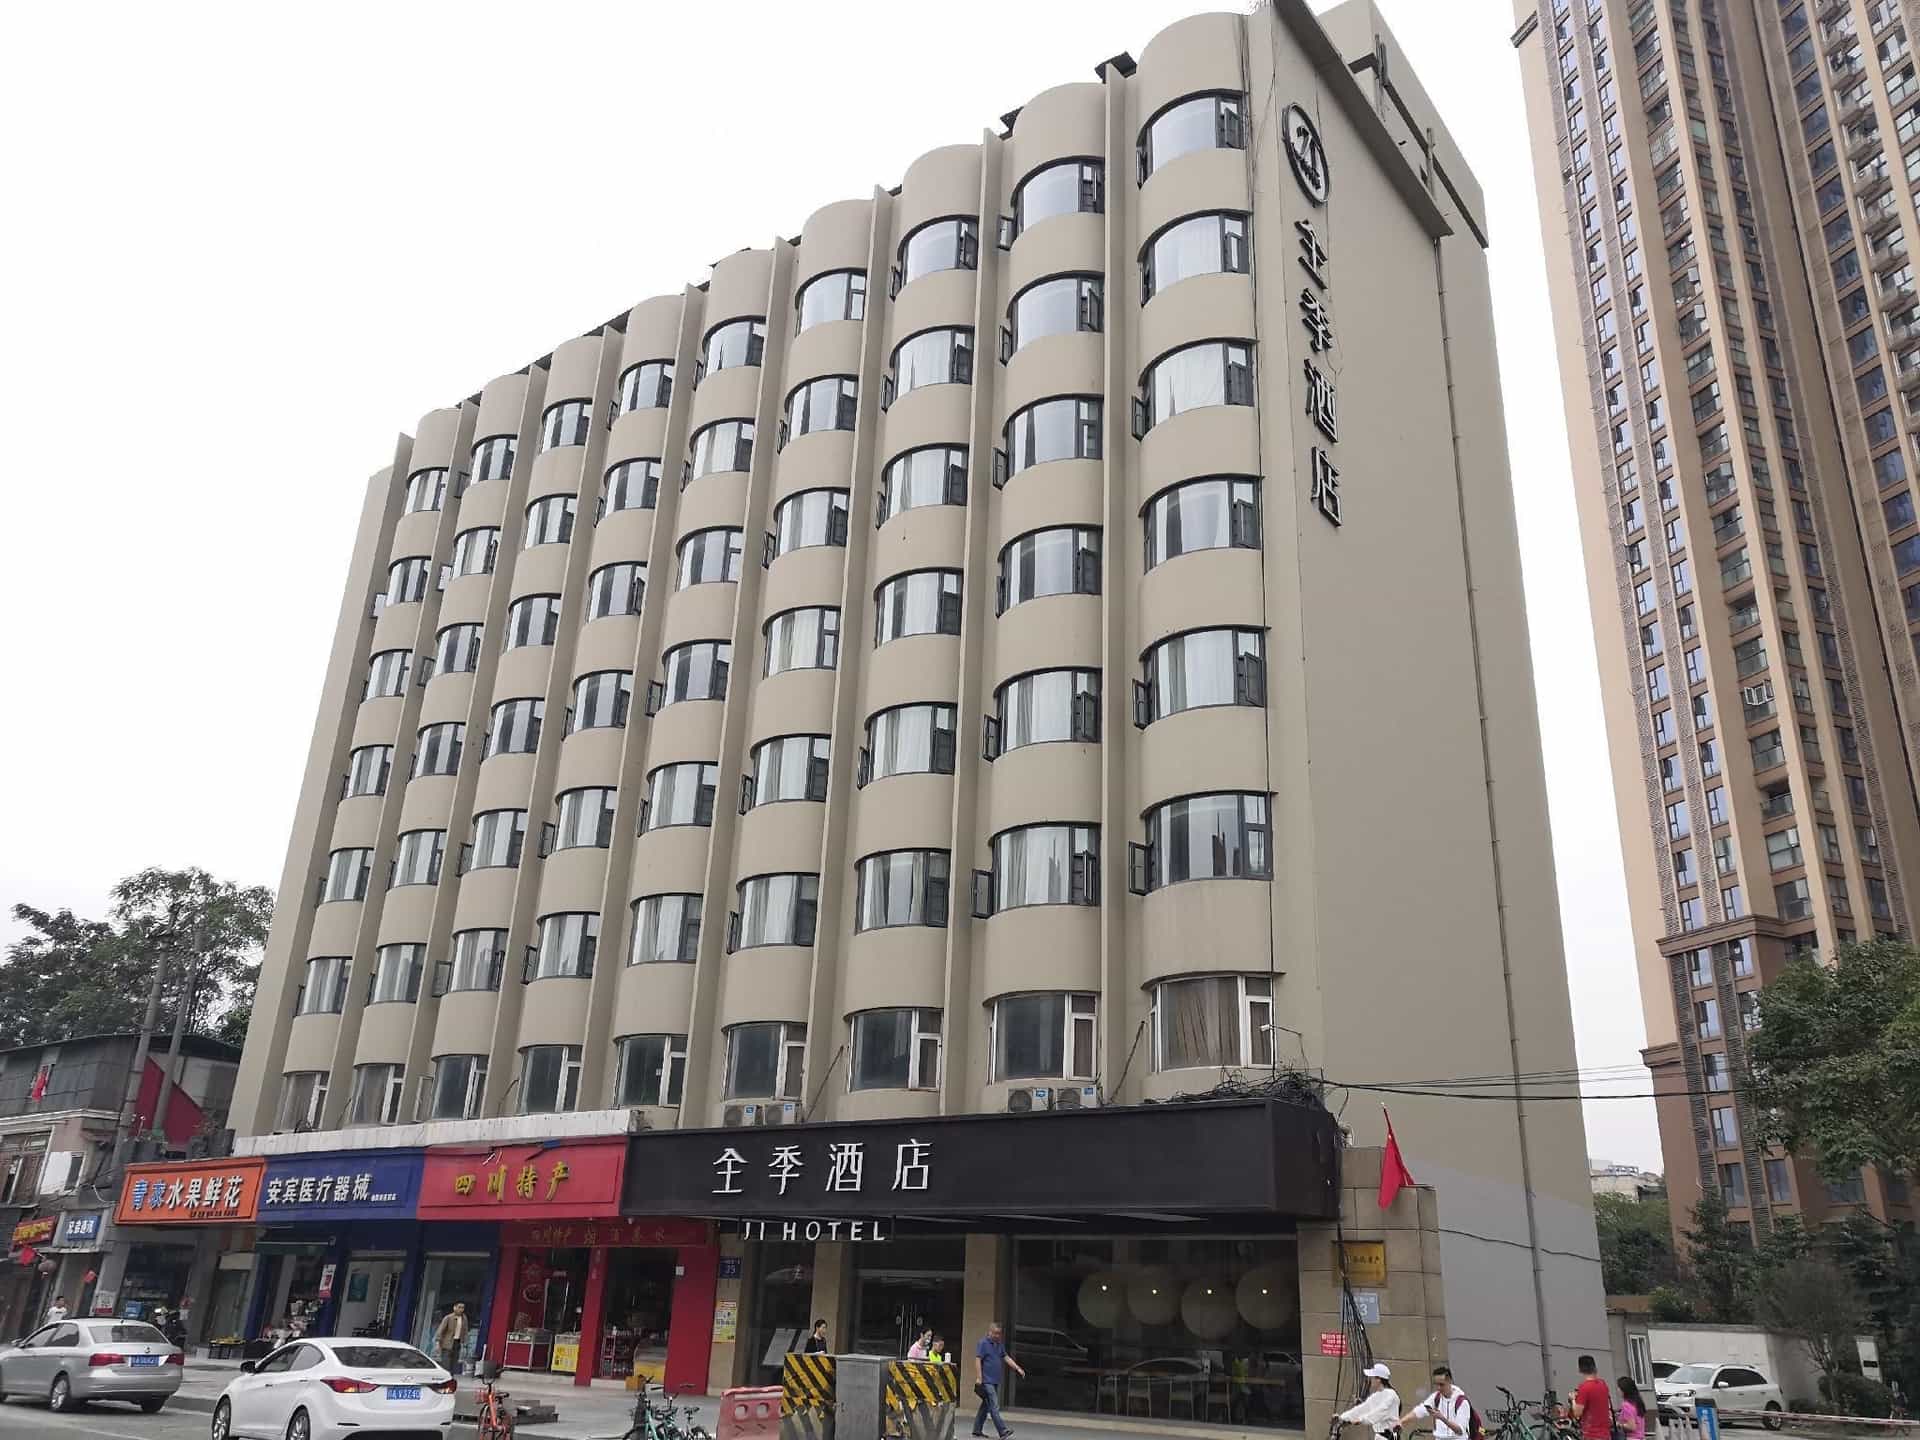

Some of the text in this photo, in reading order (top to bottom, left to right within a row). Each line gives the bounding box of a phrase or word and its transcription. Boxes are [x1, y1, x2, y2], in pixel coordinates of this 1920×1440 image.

[1295, 219, 1342, 527] 全季酒店
[455, 1161, 569, 1201] 四川特产
[712, 1139, 933, 1195] 全季酒店
[265, 1173, 373, 1204] 安宾医疗器械
[743, 1220, 886, 1241] JI HOTEL
